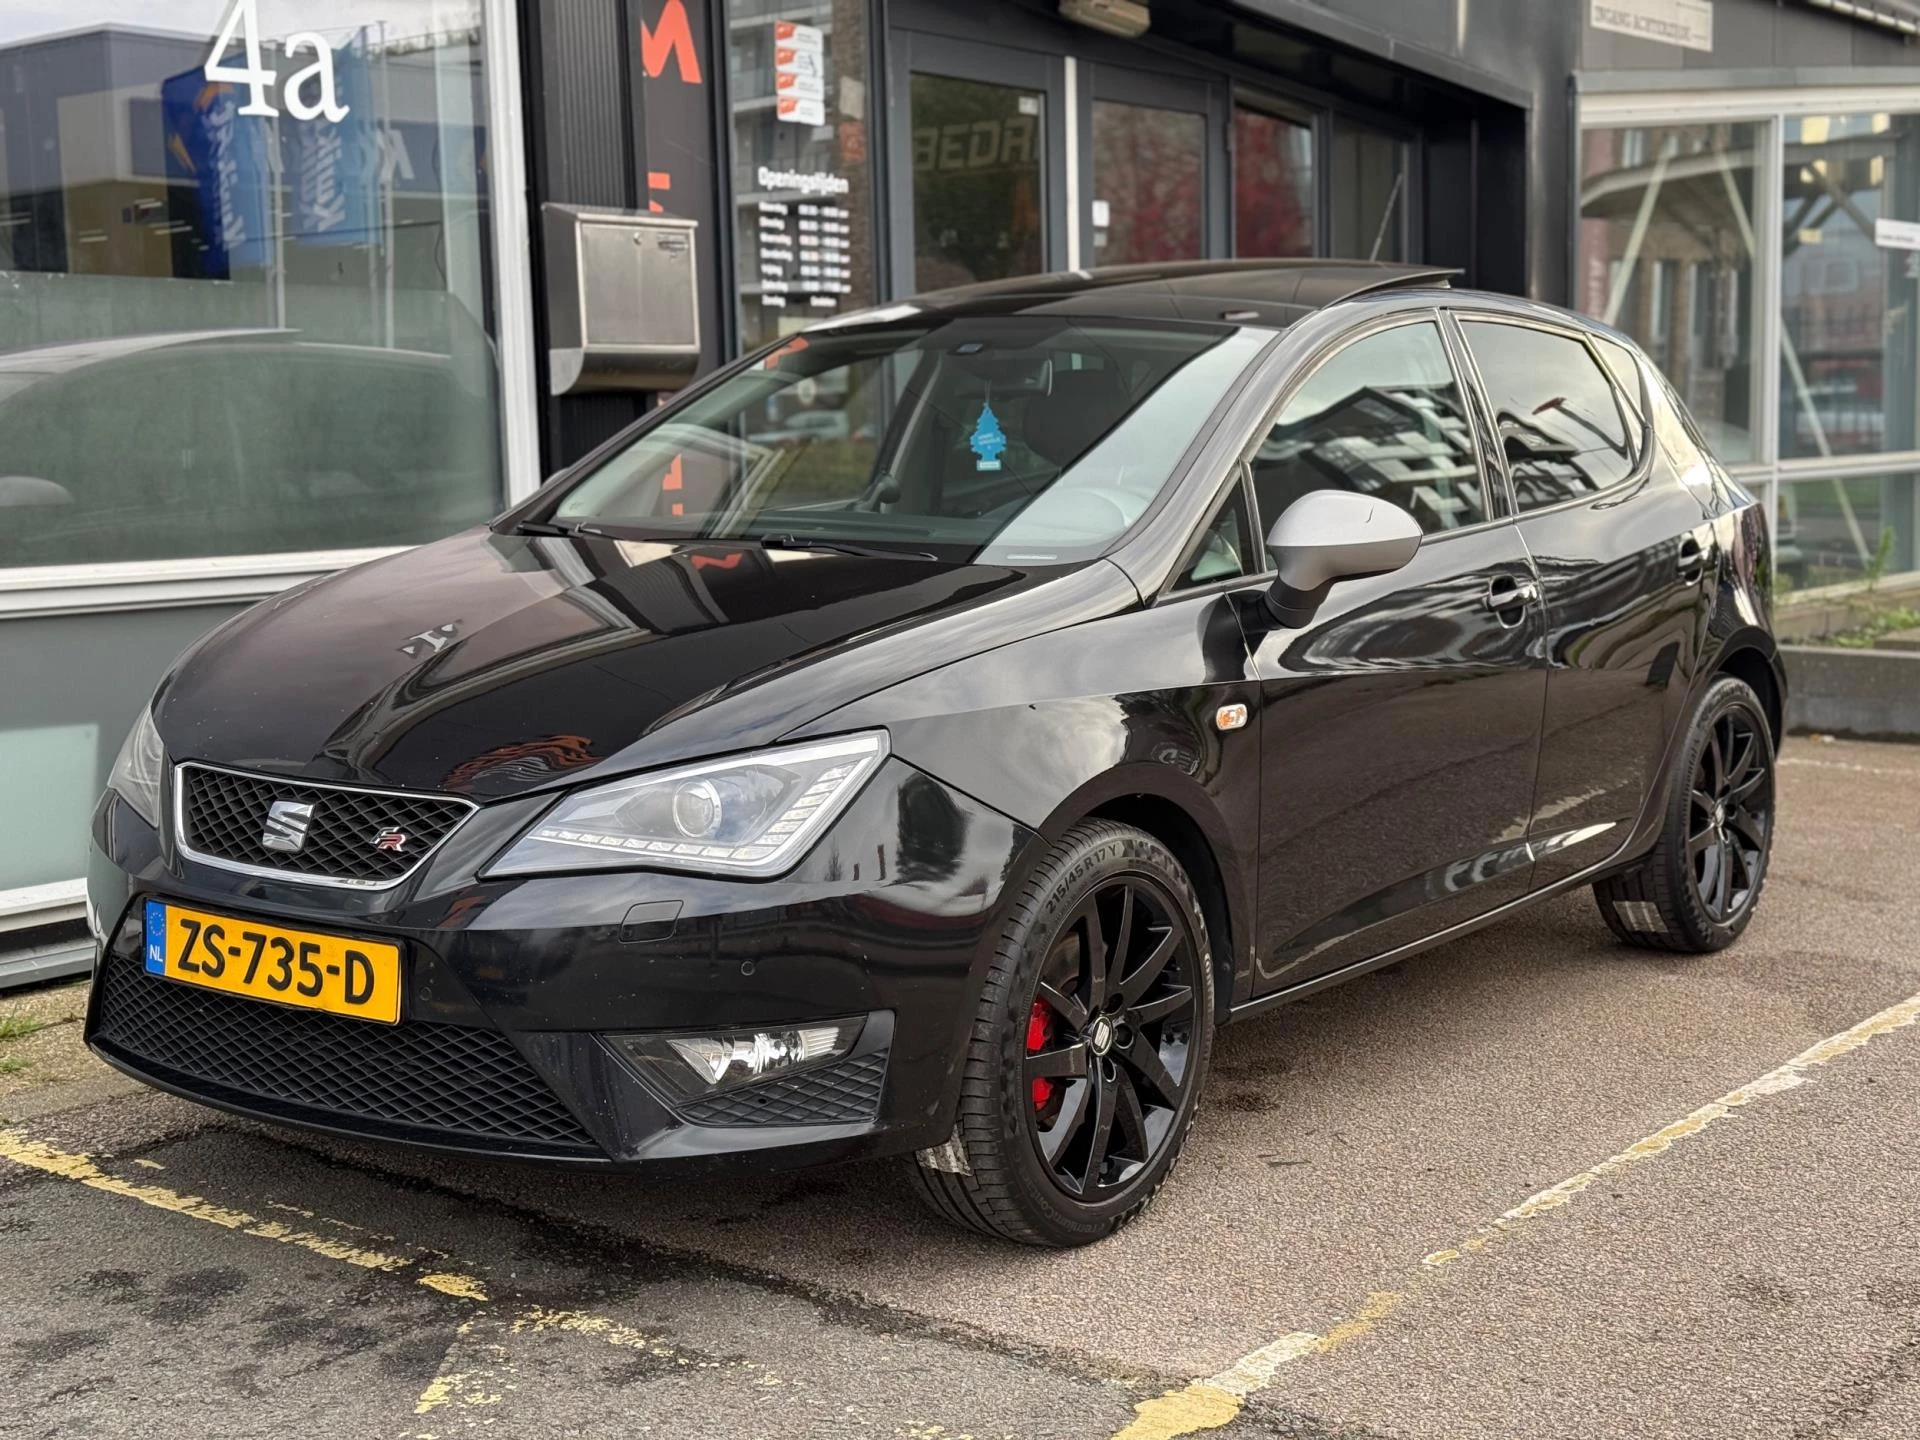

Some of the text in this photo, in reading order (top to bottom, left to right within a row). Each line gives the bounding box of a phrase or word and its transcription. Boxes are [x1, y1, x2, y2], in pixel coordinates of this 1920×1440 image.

[204, 0, 350, 123] 4a
[1046, 863, 1085, 914] 215/45
[149, 944, 164, 963] NL
[178, 918, 375, 1005] ZS-735-D
